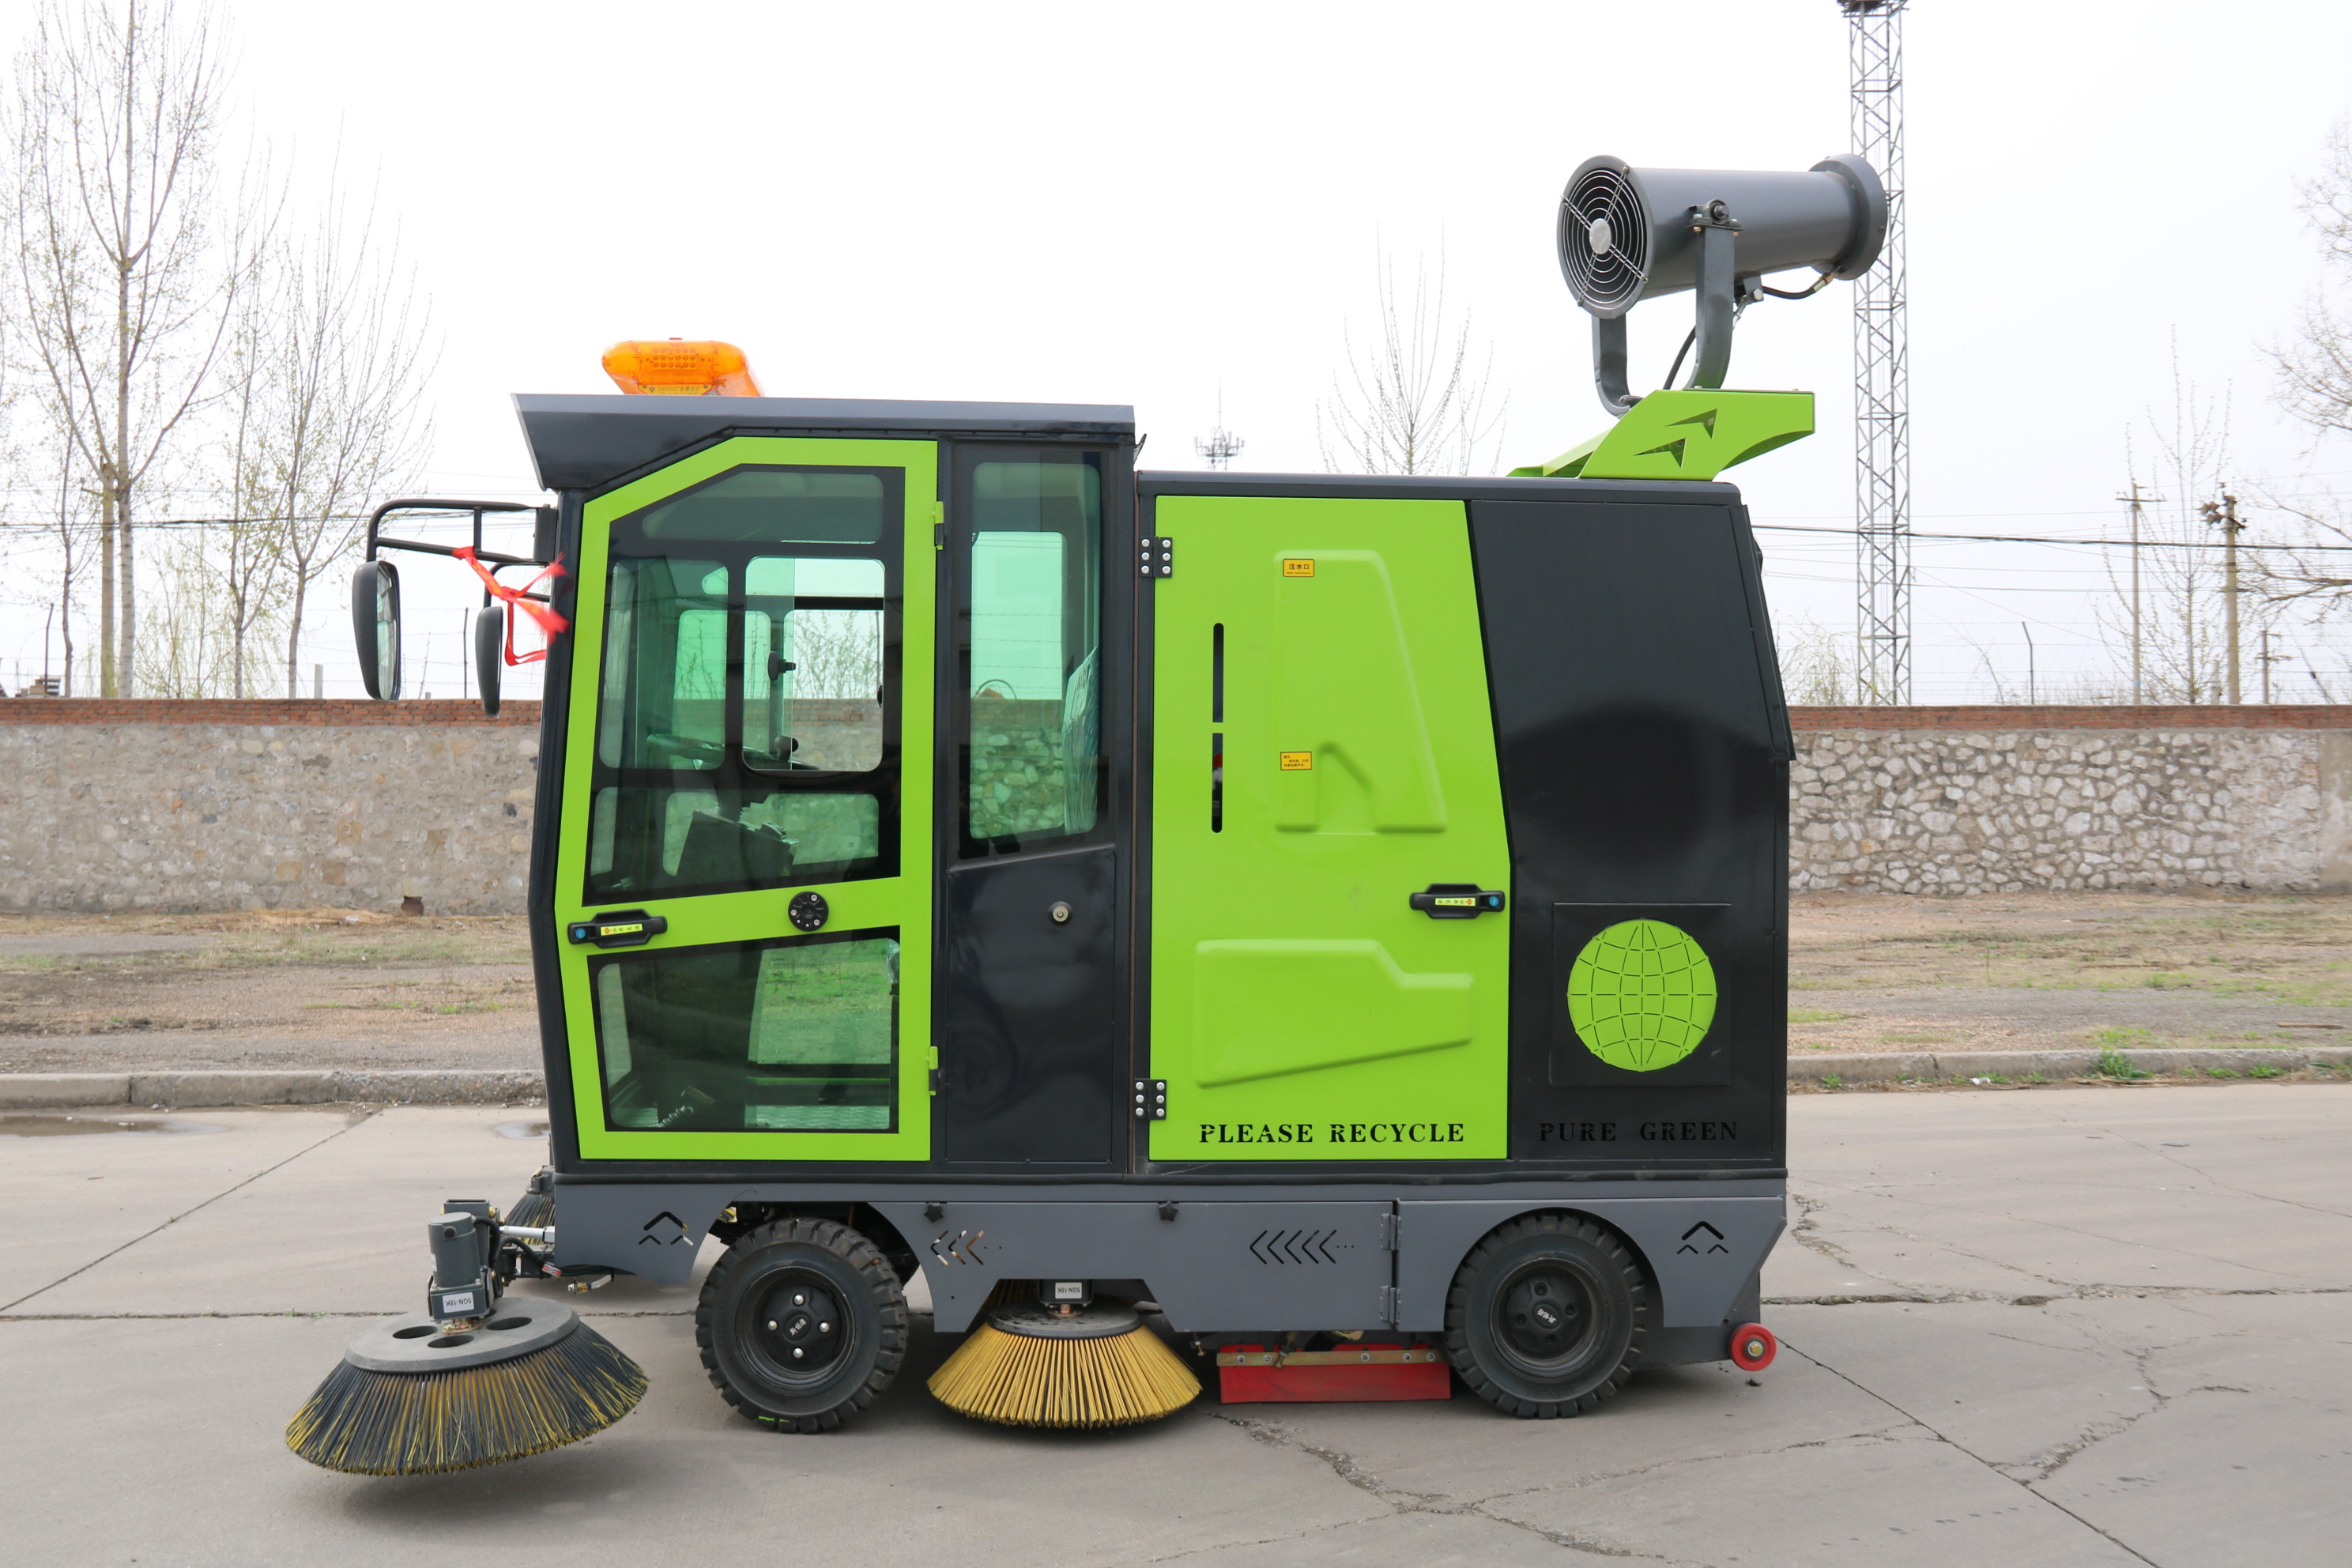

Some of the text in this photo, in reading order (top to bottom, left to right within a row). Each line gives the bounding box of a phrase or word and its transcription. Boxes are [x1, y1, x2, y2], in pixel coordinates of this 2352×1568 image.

[1200, 1123, 1464, 1143] PLEASE RECYCLE
[1539, 1121, 1738, 1142] PURE GREEN
[445, 1298, 472, 1306] 5GN-18K
